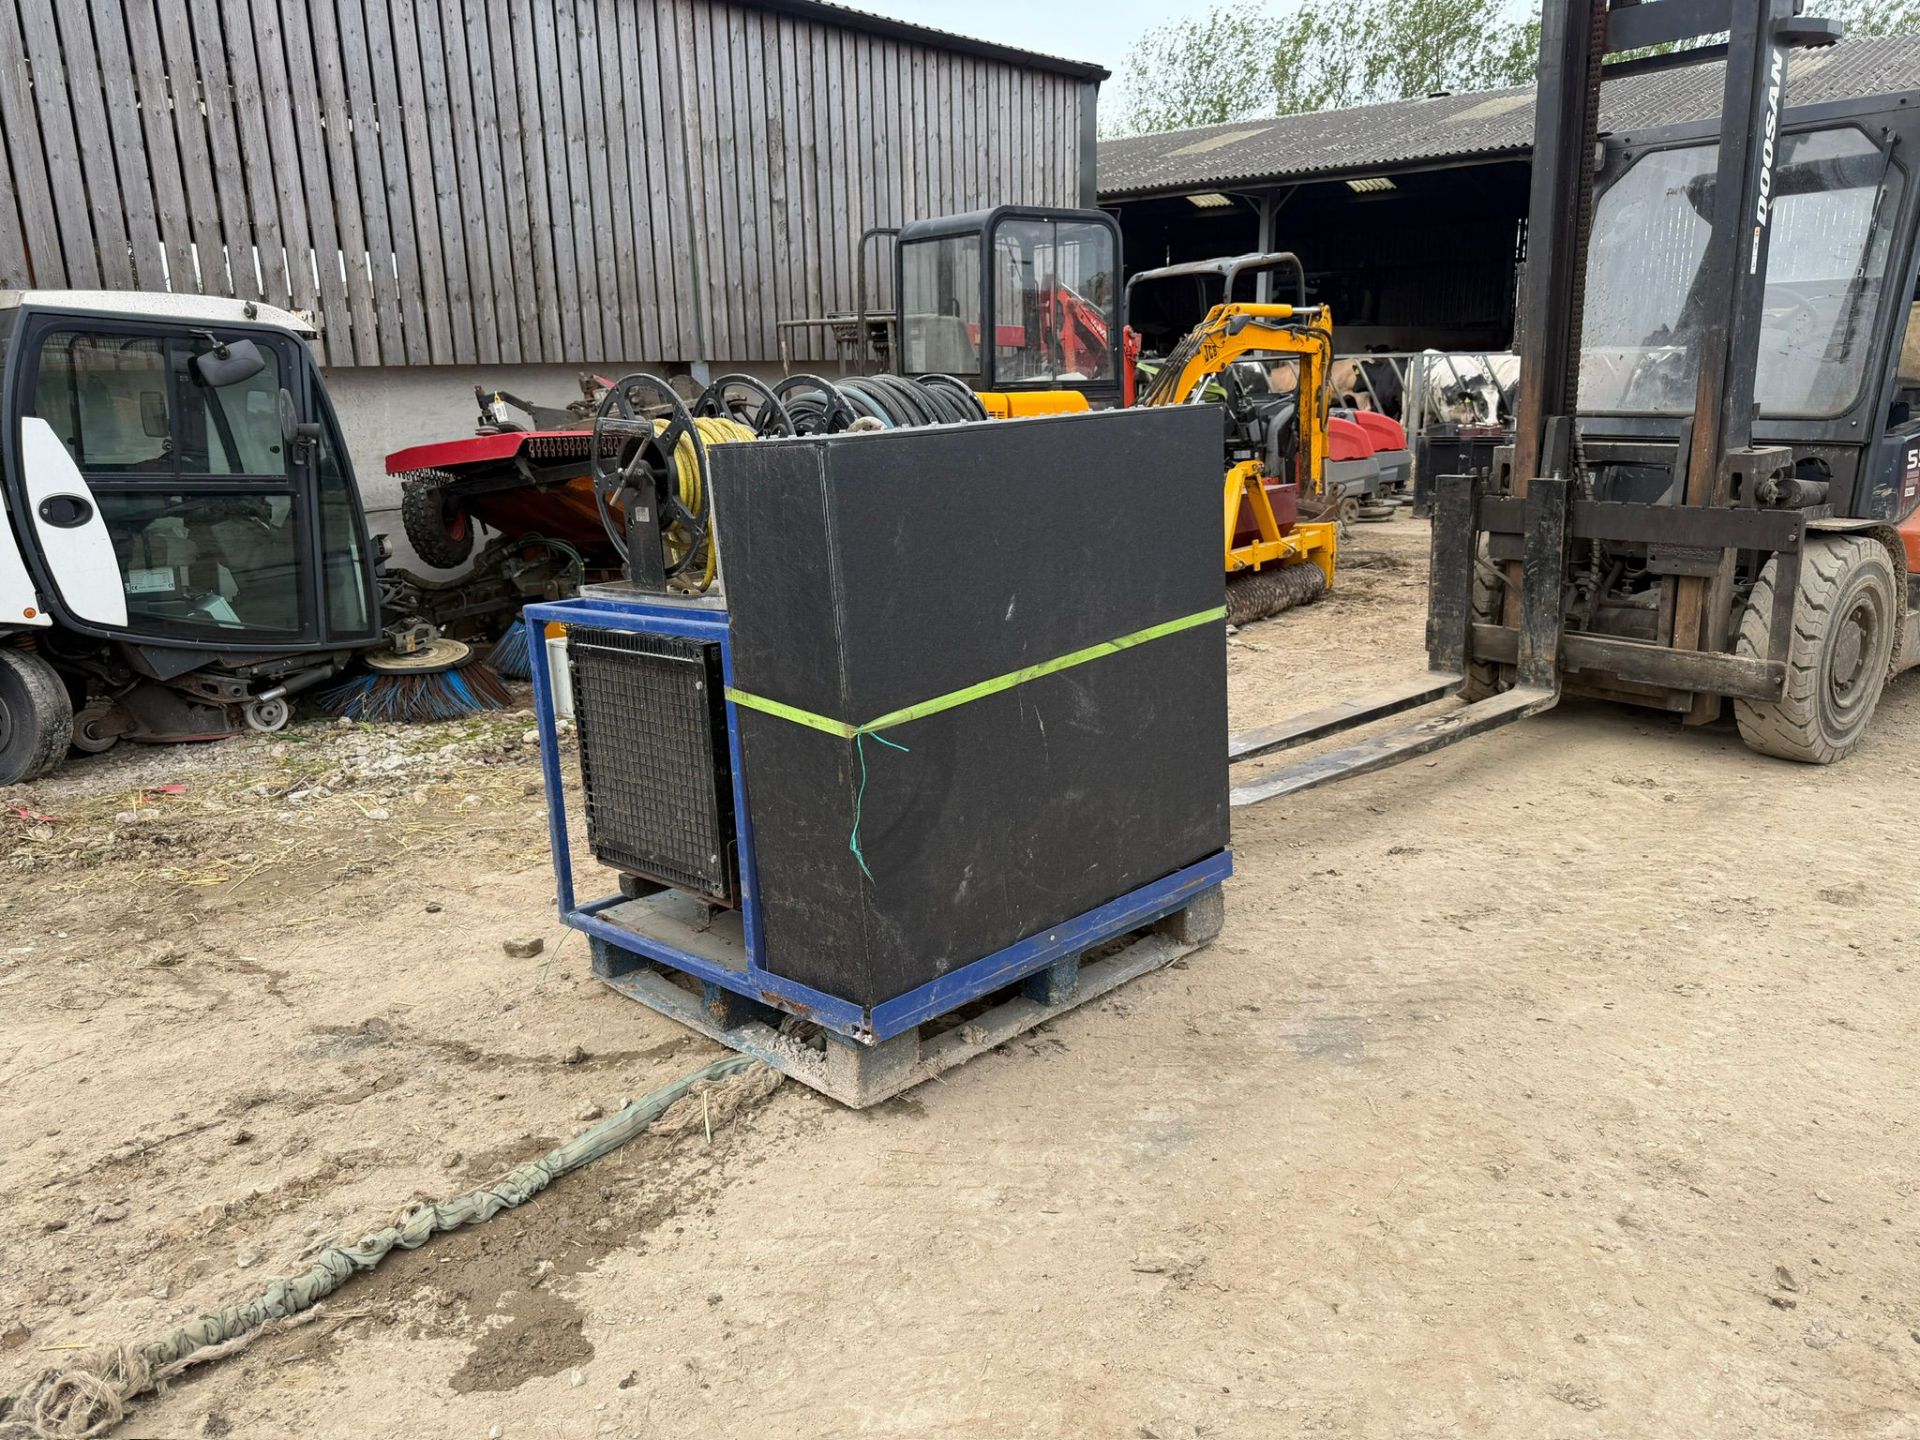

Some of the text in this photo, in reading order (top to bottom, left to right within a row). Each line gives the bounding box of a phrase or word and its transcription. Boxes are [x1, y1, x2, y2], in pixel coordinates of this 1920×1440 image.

[1756, 48, 1783, 227] DOOSAN
[1203, 344, 1218, 362] JCB
[1906, 449, 1920, 470] 5
